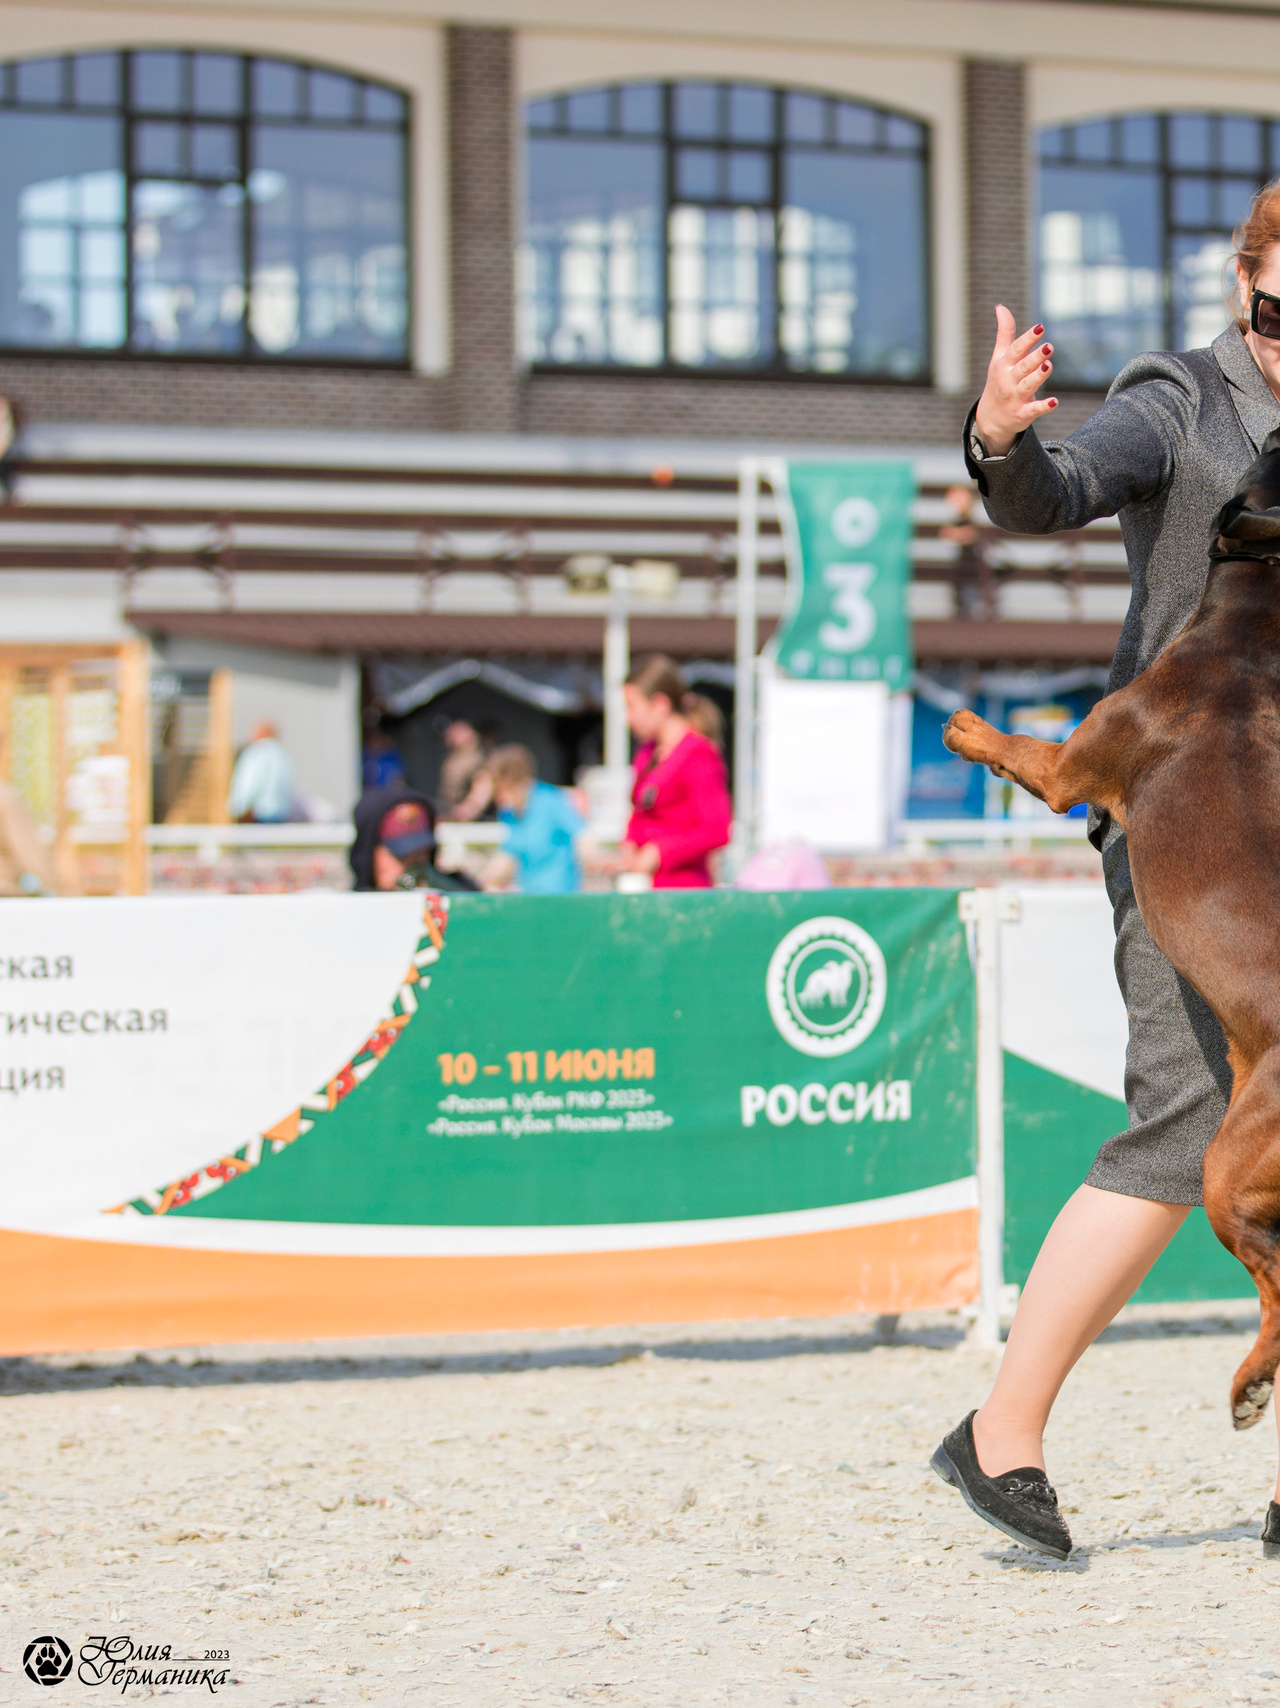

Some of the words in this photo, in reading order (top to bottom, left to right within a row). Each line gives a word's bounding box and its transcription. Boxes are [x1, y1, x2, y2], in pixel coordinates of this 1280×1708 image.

[818, 562, 877, 654] 3
[0, 954, 73, 980] кая
[437, 1052, 477, 1085] 10
[506, 1050, 538, 1083] 11
[545, 1047, 655, 1082] ИЮНЯ
[740, 1080, 912, 1127] РОССИЯ
